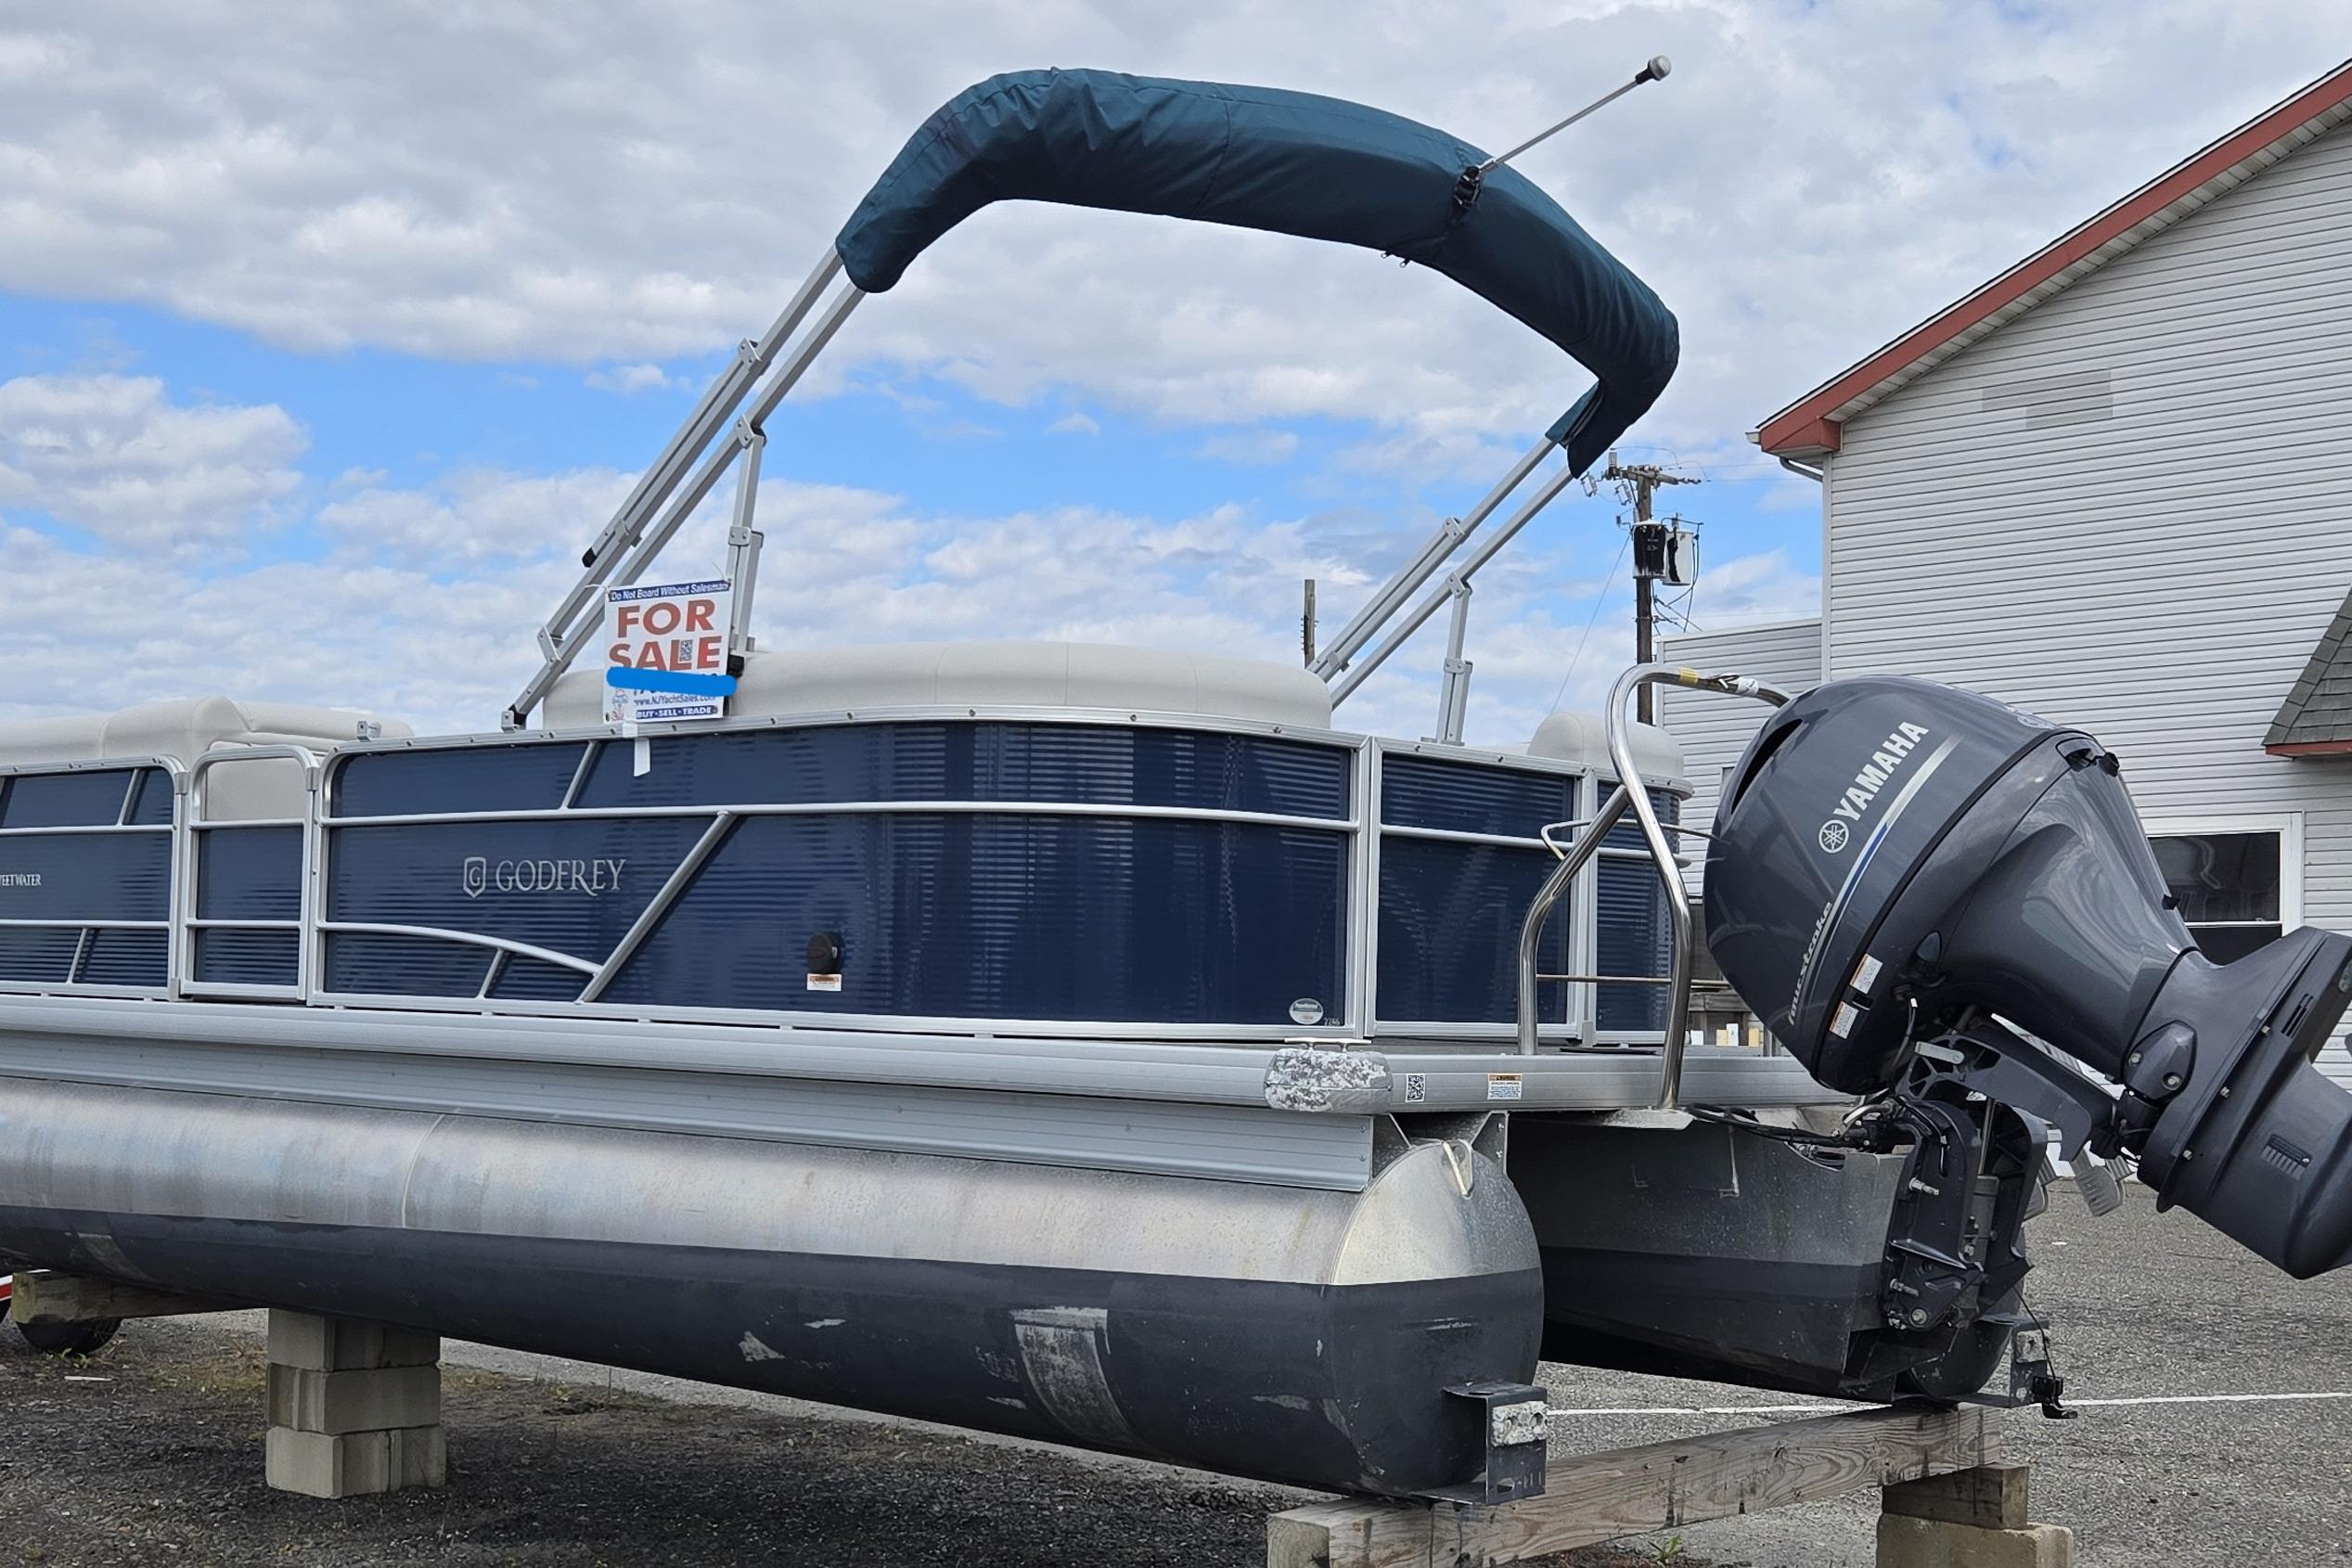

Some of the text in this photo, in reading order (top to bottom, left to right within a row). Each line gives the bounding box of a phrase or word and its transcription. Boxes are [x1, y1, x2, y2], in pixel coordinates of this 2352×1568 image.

[611, 591, 623, 601] Do
[623, 589, 636, 599] Not
[636, 587, 660, 598] Board
[660, 585, 690, 596] Without
[617, 598, 715, 638] FOR
[609, 636, 722, 672] SALE
[1832, 721, 1930, 821] YAMAHA
[0, 873, 42, 886] EETWATER
[495, 858, 627, 897] GODFREY
